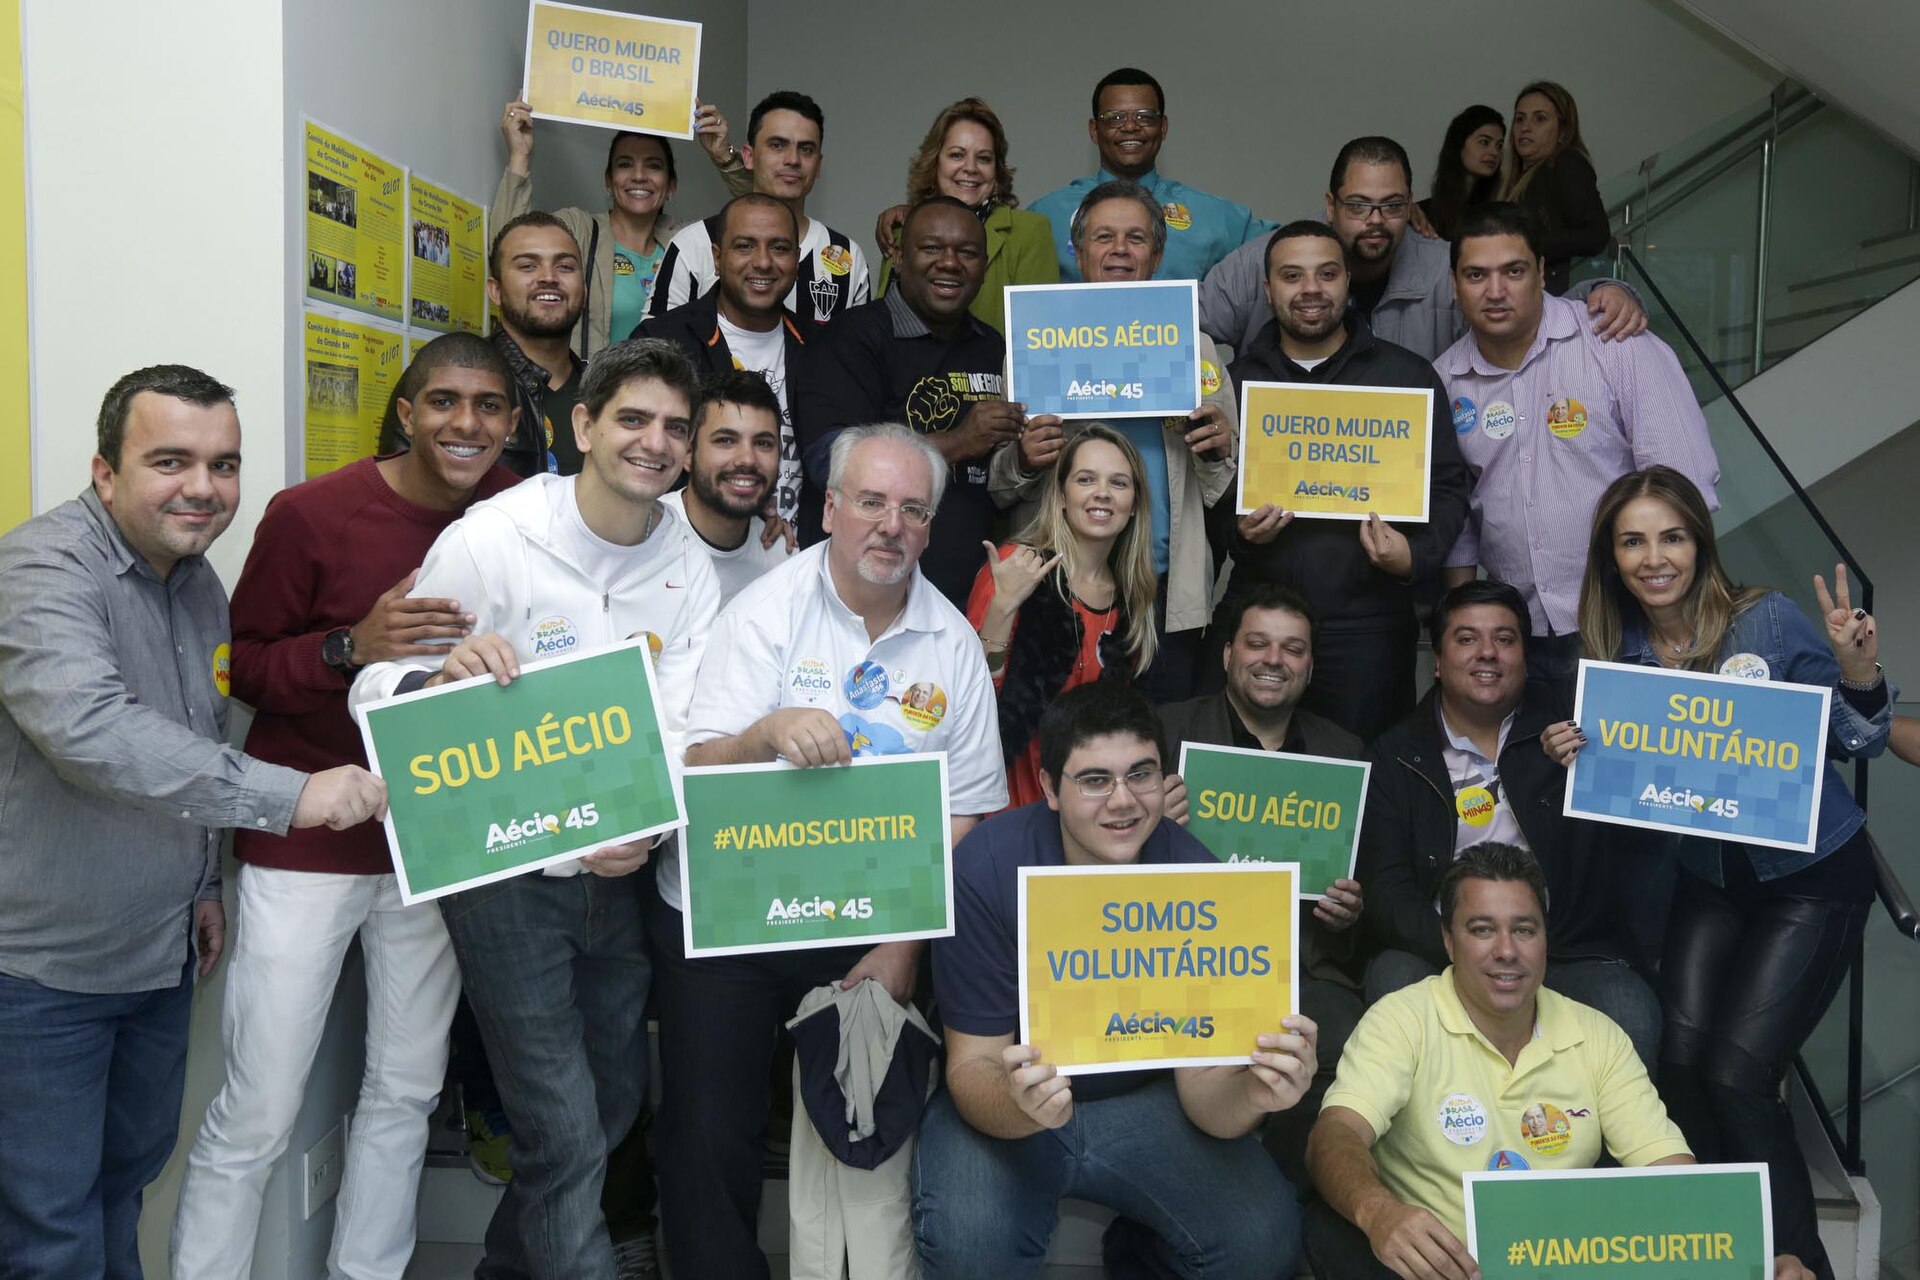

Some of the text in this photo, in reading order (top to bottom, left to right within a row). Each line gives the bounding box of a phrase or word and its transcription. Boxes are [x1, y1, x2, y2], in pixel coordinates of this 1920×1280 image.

[547, 29, 681, 65] QUERO MUDAR
[571, 56, 655, 84] O BRASIL
[624, 102, 644, 116] 45
[813, 283, 835, 293] CAM
[1026, 320, 1180, 350] SOMOS AÉCIO
[1067, 380, 1144, 399] Aécio 45
[1262, 413, 1410, 439] QUERO MUDAR
[1485, 415, 1514, 429] Aécio
[1288, 441, 1380, 464] O BRASIL
[1294, 480, 1370, 502] Aécio 45
[535, 634, 576, 654] Aécio
[536, 626, 569, 639] BRASIL
[792, 674, 831, 689] Aécio
[797, 666, 827, 676] BRASIL
[849, 673, 886, 700] Anastasia
[1667, 693, 1734, 727] SOU
[409, 705, 633, 795] SOU AÉCIO
[1599, 718, 1800, 771] VOLUNTÁRIO
[1197, 789, 1341, 830] SOU AÉCIO
[1639, 783, 1739, 819] Aécio 45
[485, 802, 600, 849] Aécio 45
[713, 814, 917, 850] #VAMOSCURTIR
[766, 895, 873, 921] Aécio 45
[1101, 900, 1218, 933] SOMOS
[1046, 938, 1271, 982] VOLUNTÁRIOS
[1105, 1011, 1215, 1039] Aécio 45
[1444, 1113, 1484, 1128] Aécio
[1445, 1105, 1477, 1115] BRASIL
[1507, 1232, 1735, 1267] #VAMOSCURTIR
